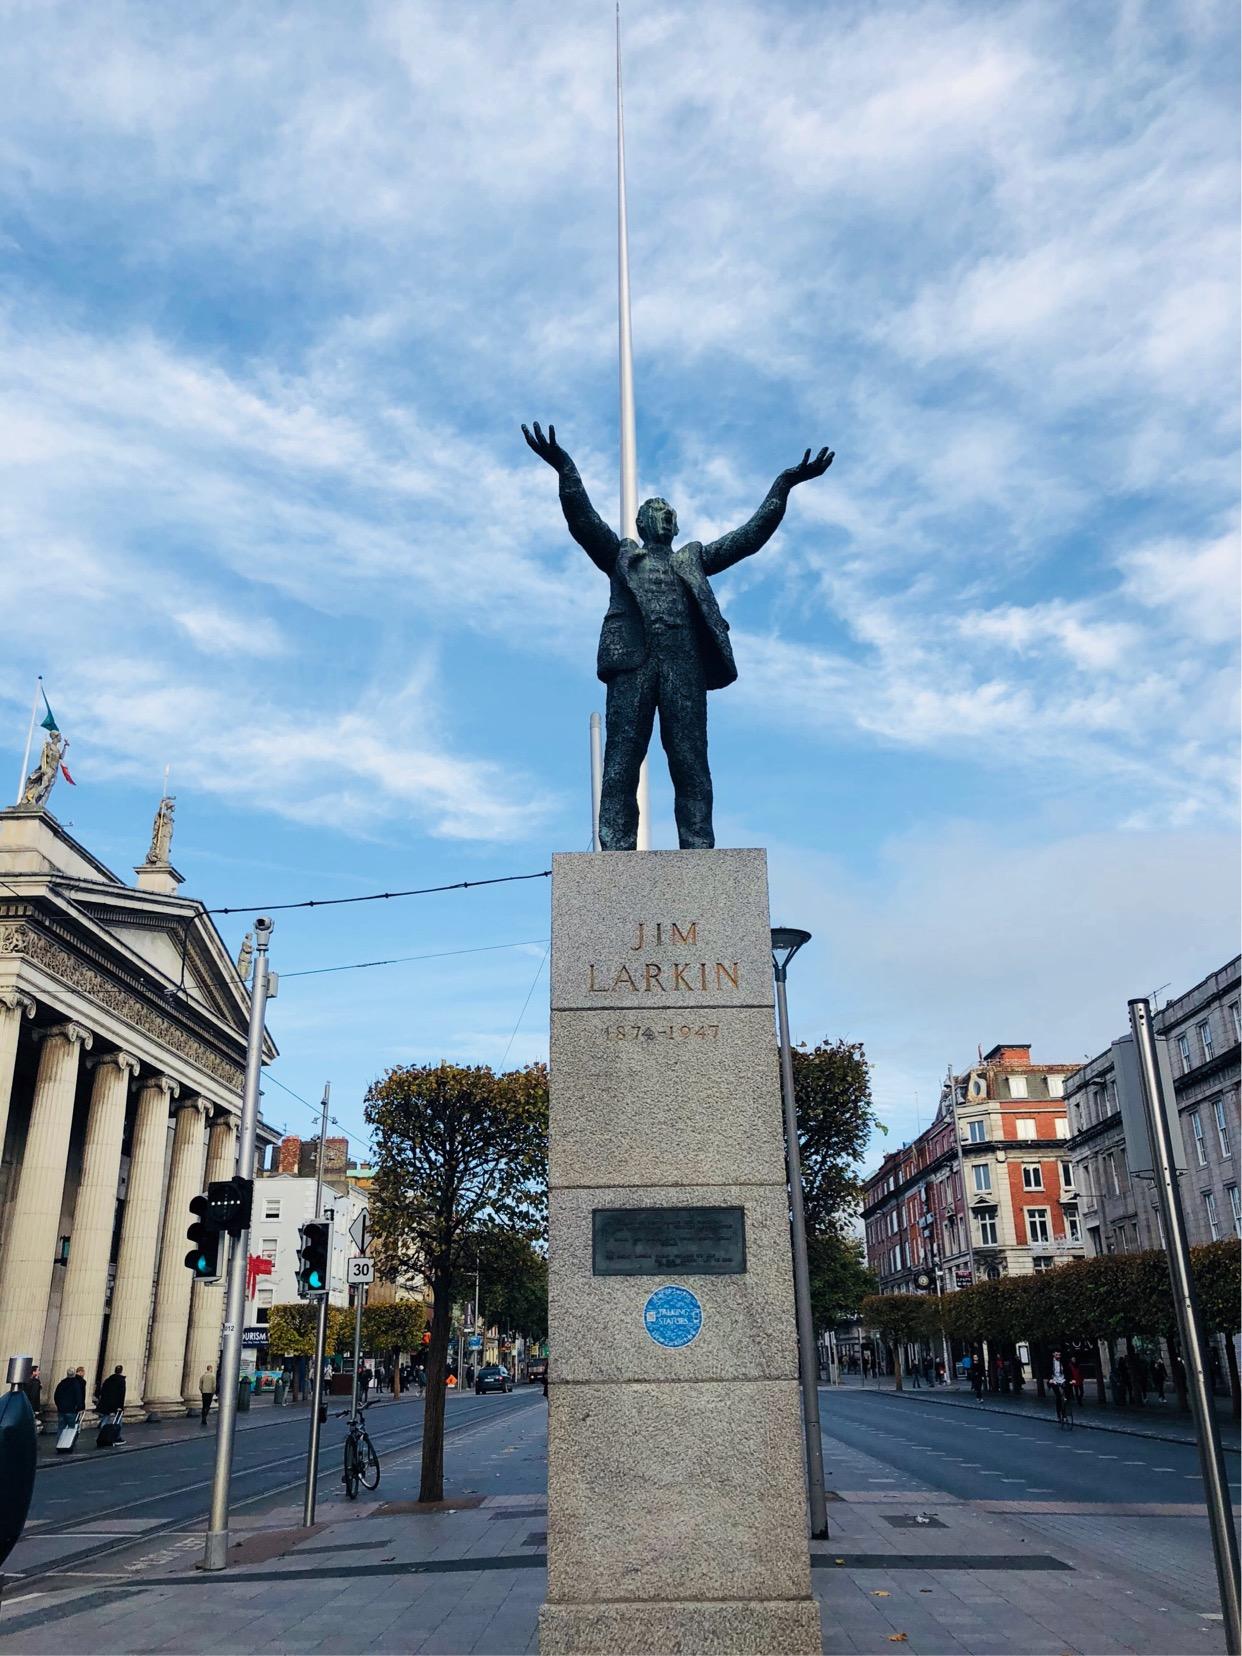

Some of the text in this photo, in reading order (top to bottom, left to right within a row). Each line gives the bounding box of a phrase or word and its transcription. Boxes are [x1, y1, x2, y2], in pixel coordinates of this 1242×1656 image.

[630, 922, 698, 951] JIM
[589, 962, 739, 992] LARKIN
[353, 1263, 370, 1277] 30
[658, 1317, 689, 1326] STATUES
